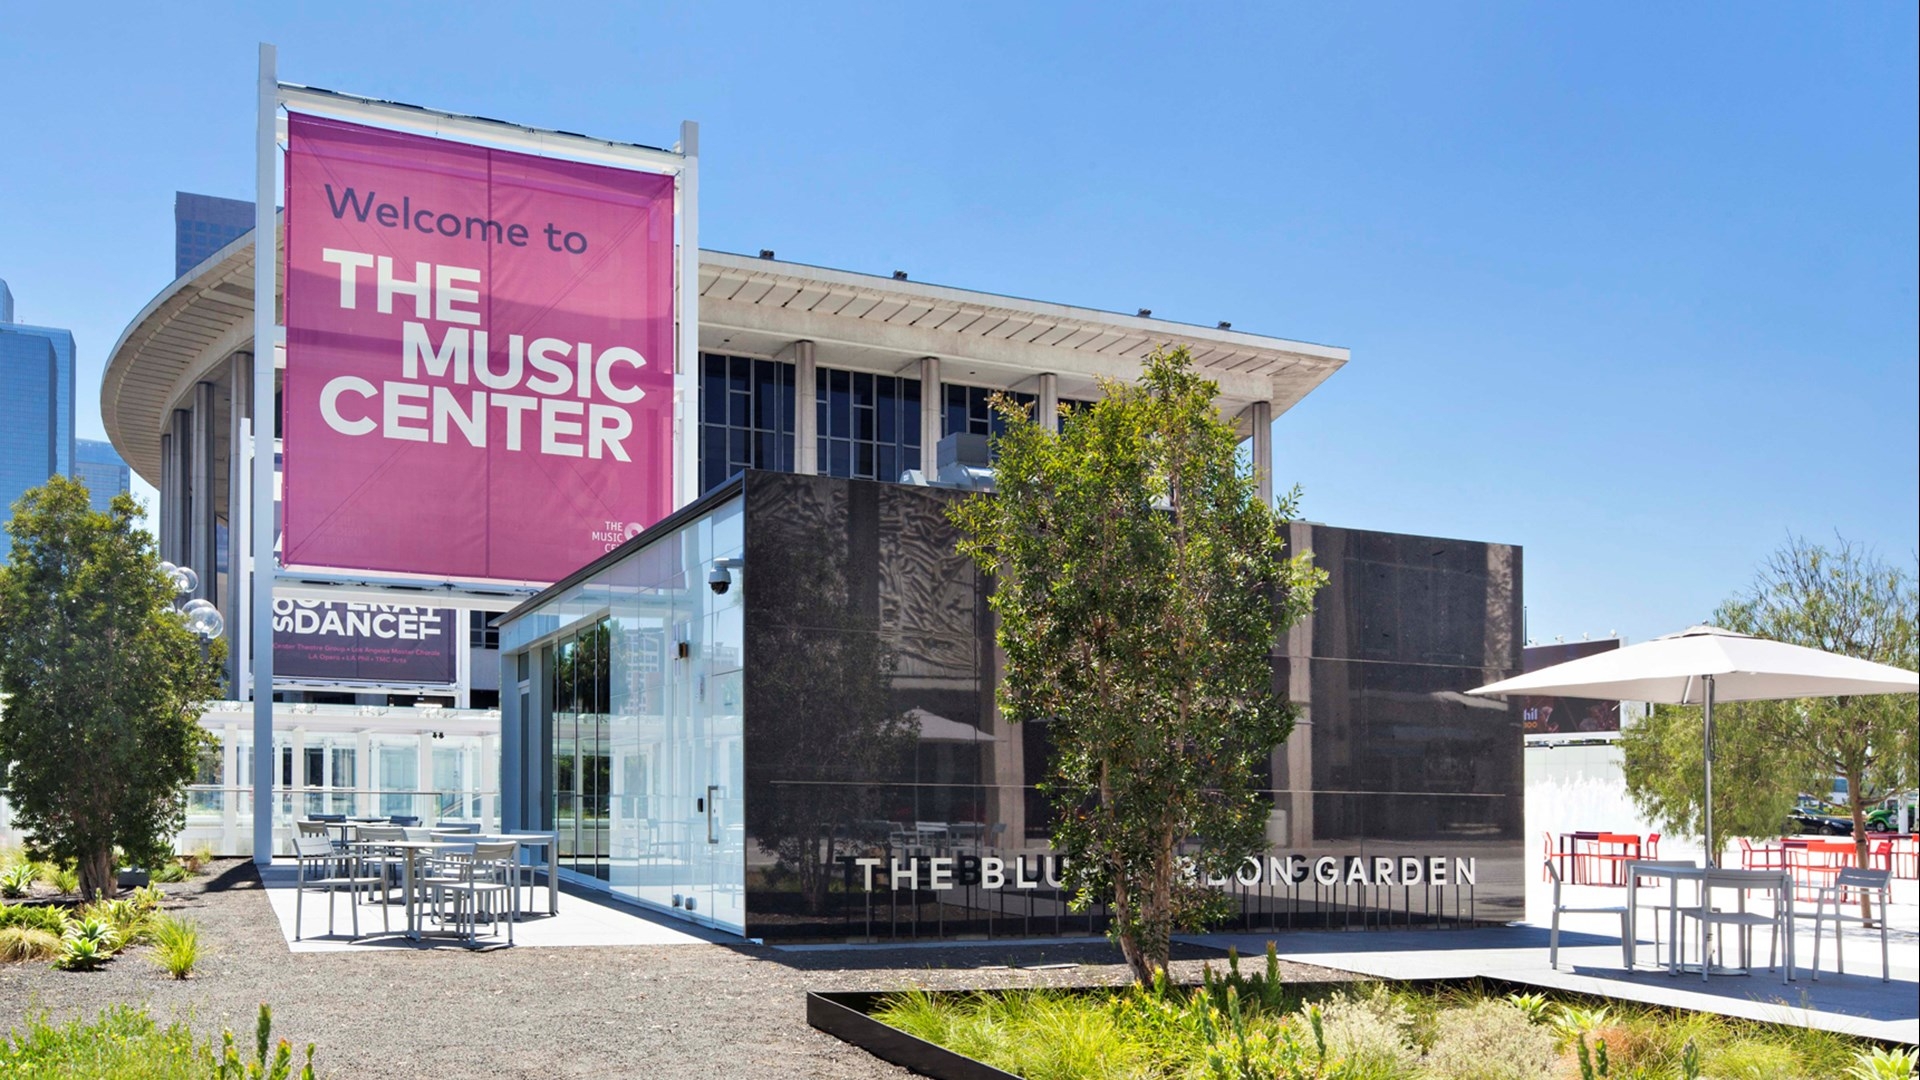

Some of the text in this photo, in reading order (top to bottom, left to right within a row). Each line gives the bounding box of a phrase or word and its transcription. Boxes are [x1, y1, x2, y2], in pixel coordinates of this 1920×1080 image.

[324, 183, 588, 255] Welcome to
[322, 247, 481, 326] THE
[402, 320, 647, 404] MUSIC
[319, 375, 634, 463] CENTER
[591, 531, 623, 542] MUSIC
[605, 520, 624, 531] THE
[294, 608, 418, 639] DANCE
[319, 654, 340, 662] Opera
[325, 645, 346, 653] Group
[365, 647, 391, 656] Angeles
[391, 648, 415, 656] Master
[1523, 707, 1538, 721] hil
[855, 857, 953, 891] THE
[981, 856, 1102, 889] BLU
[1315, 855, 1476, 887] GARDEN
